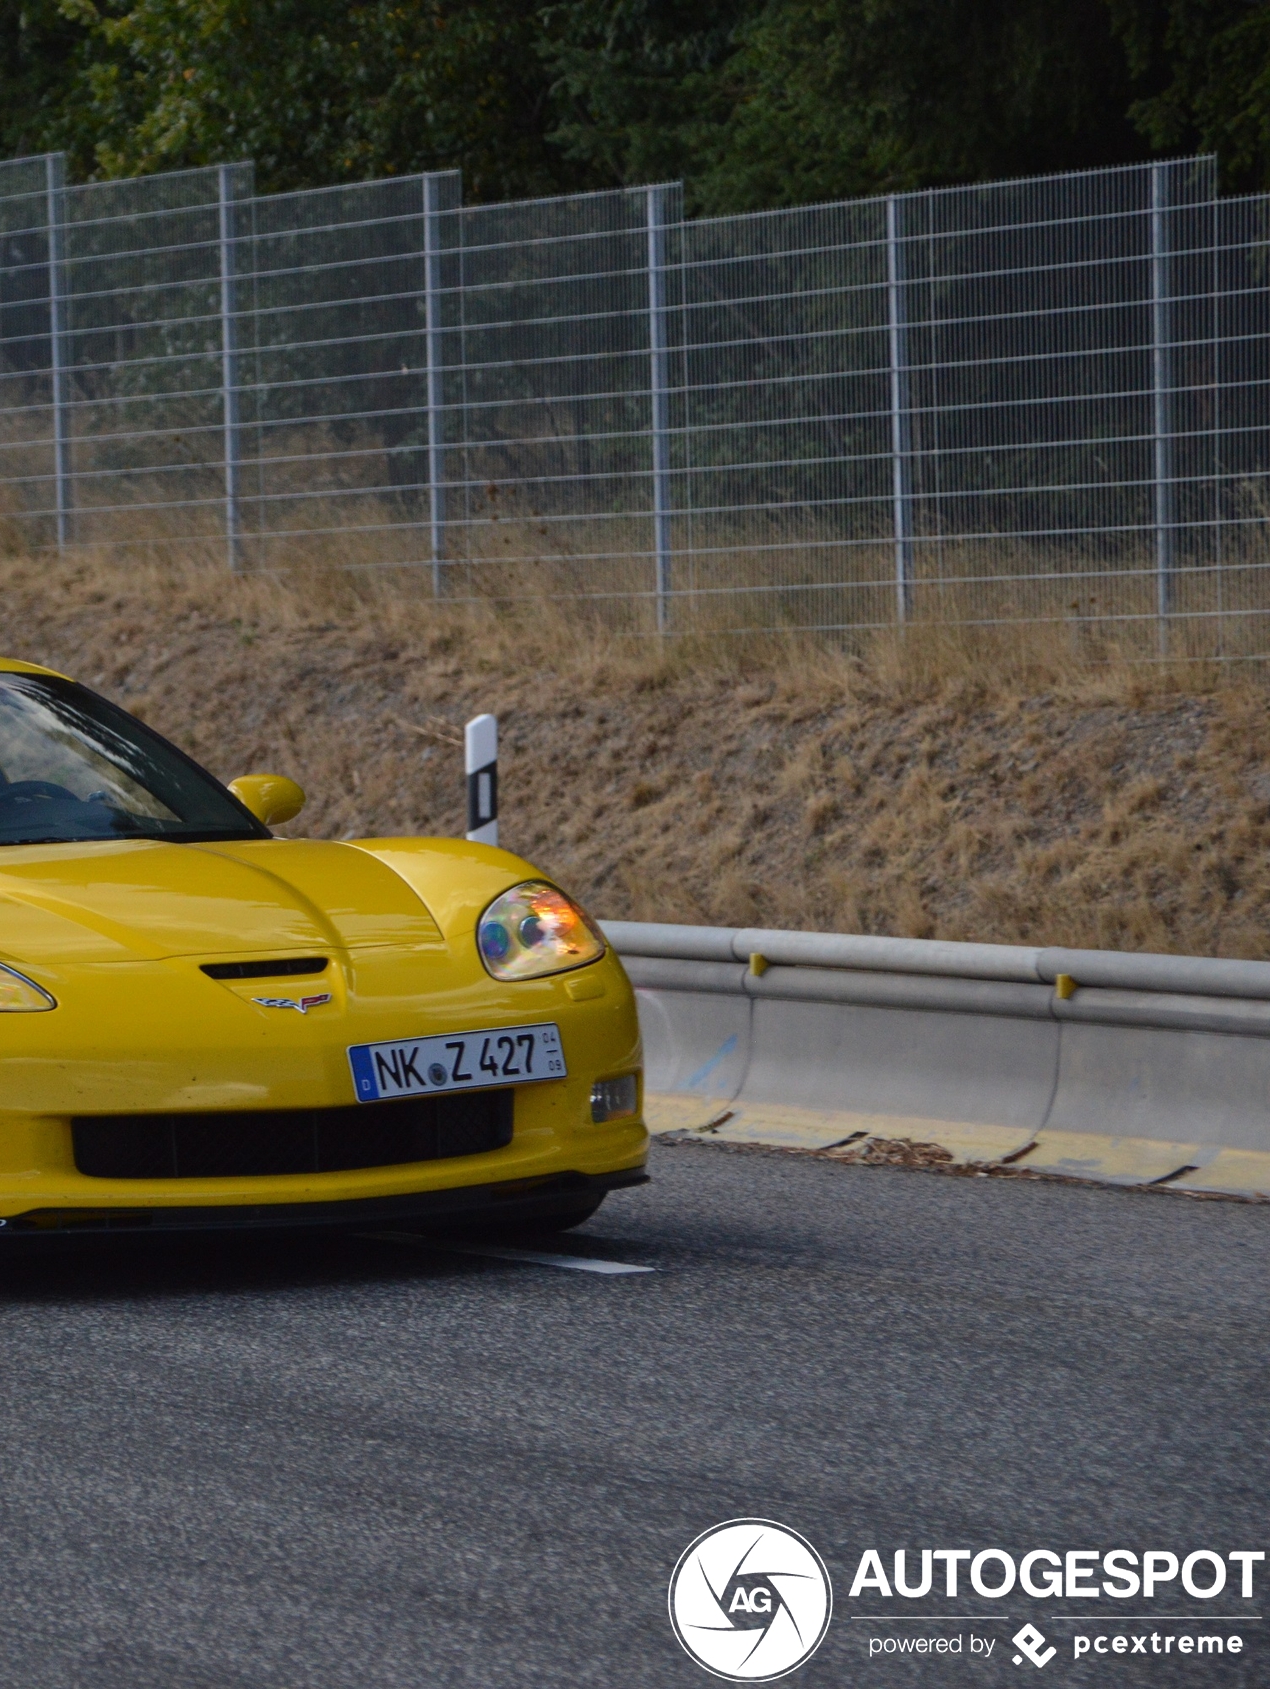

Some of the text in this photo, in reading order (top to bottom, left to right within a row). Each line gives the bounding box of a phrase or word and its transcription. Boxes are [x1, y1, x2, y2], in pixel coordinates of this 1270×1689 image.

[375, 1034, 535, 1090] NK Z 427
